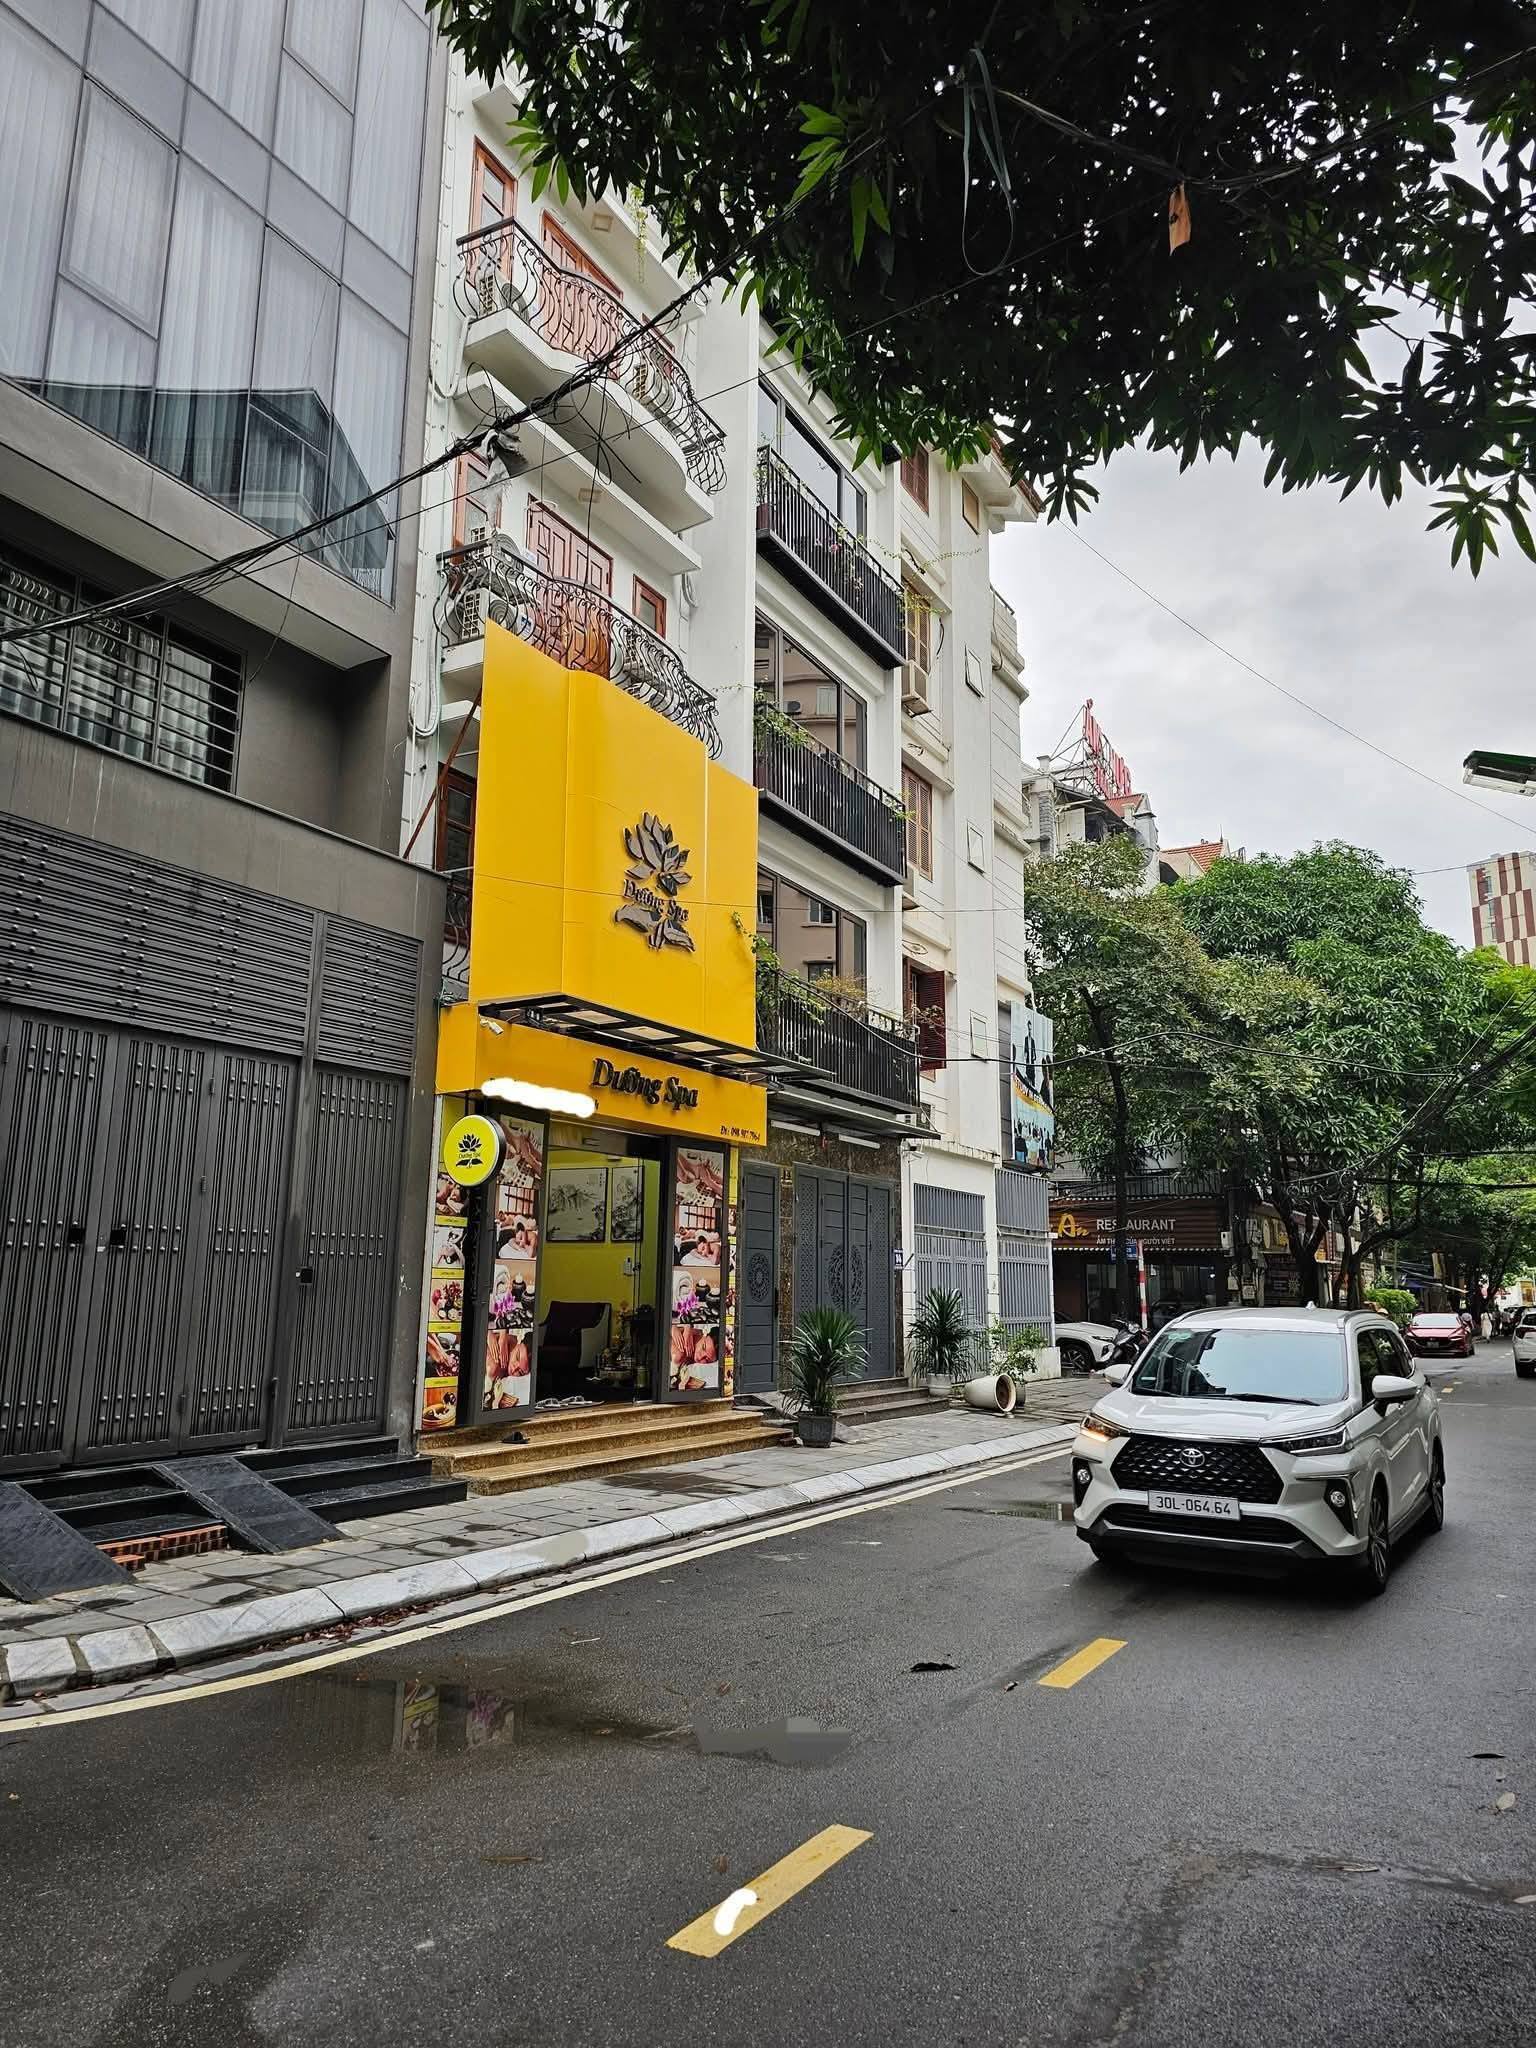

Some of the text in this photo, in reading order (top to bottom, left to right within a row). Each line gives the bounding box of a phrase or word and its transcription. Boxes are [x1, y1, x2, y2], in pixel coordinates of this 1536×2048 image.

[592, 1058, 698, 1110] Dưỡng Spa
[1096, 1219, 1176, 1231] RESAURANT
[1156, 1496, 1231, 1514] 30L-064.64
